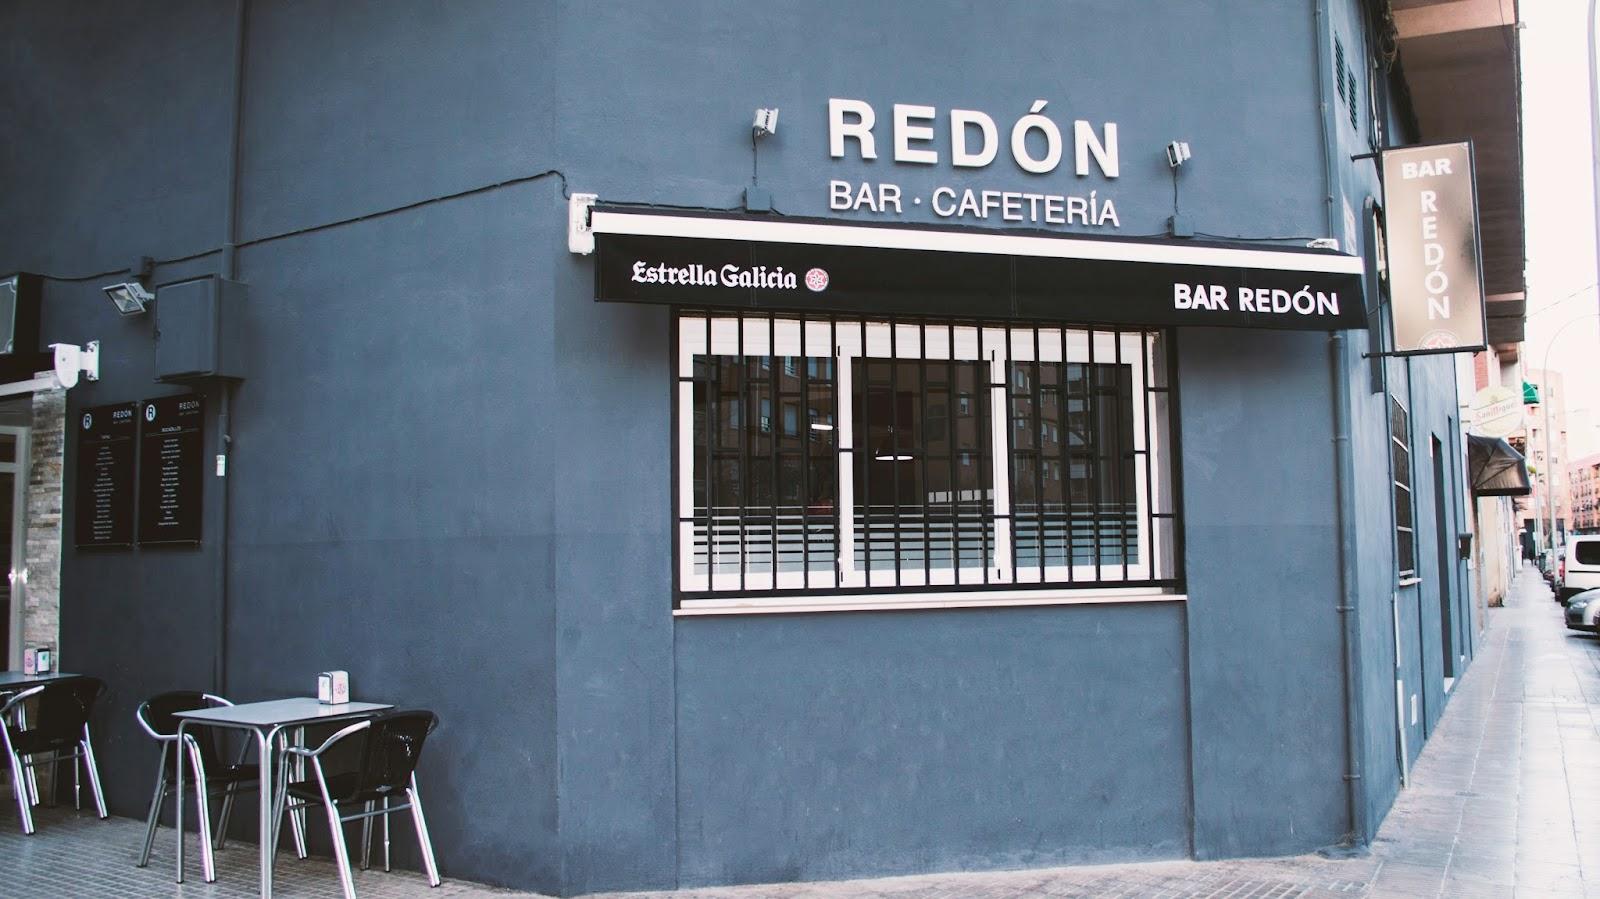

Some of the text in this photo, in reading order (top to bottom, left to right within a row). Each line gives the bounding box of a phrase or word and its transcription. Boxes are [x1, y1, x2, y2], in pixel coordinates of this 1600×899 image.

[829, 98, 1120, 178] REDÓN
[1402, 158, 1452, 179] BAR
[830, 180, 1120, 227] BAR CAFETERÍA
[1420, 190, 1450, 320] REDÓN
[631, 260, 797, 290] Estrella Galicia
[1174, 283, 1339, 315] BAR REDÓN
